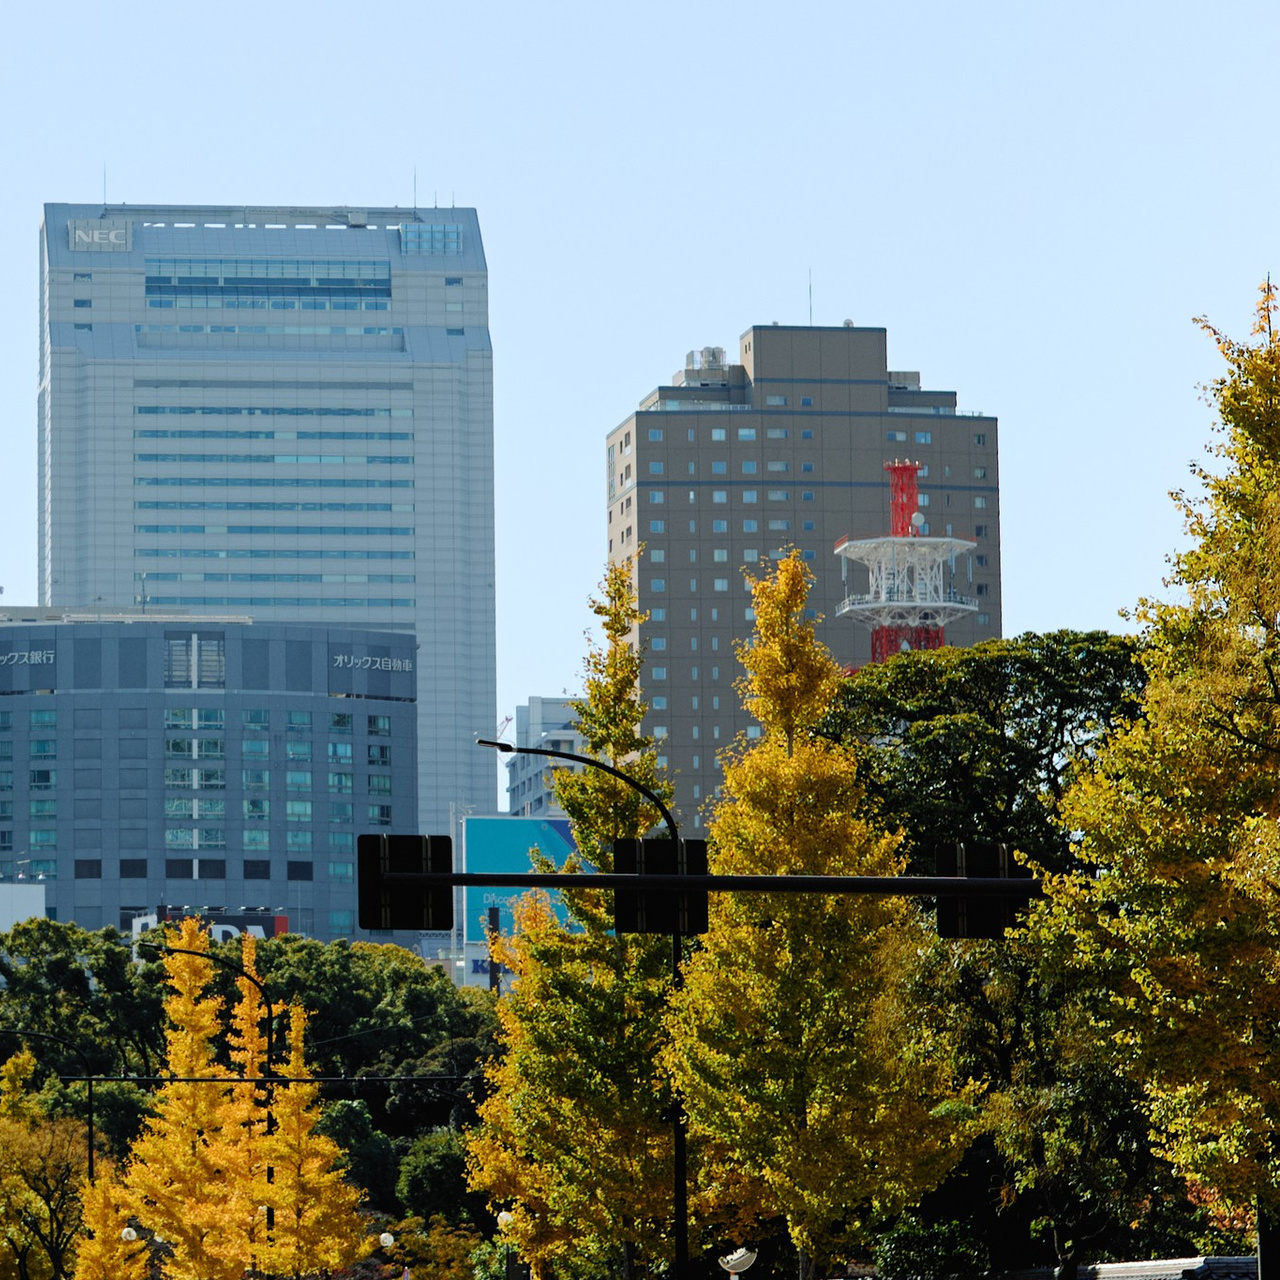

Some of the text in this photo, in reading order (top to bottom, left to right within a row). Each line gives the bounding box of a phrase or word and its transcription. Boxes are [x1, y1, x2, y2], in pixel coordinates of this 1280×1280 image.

[75, 229, 126, 244] NEC
[333, 654, 413, 672] オリックス自動車
